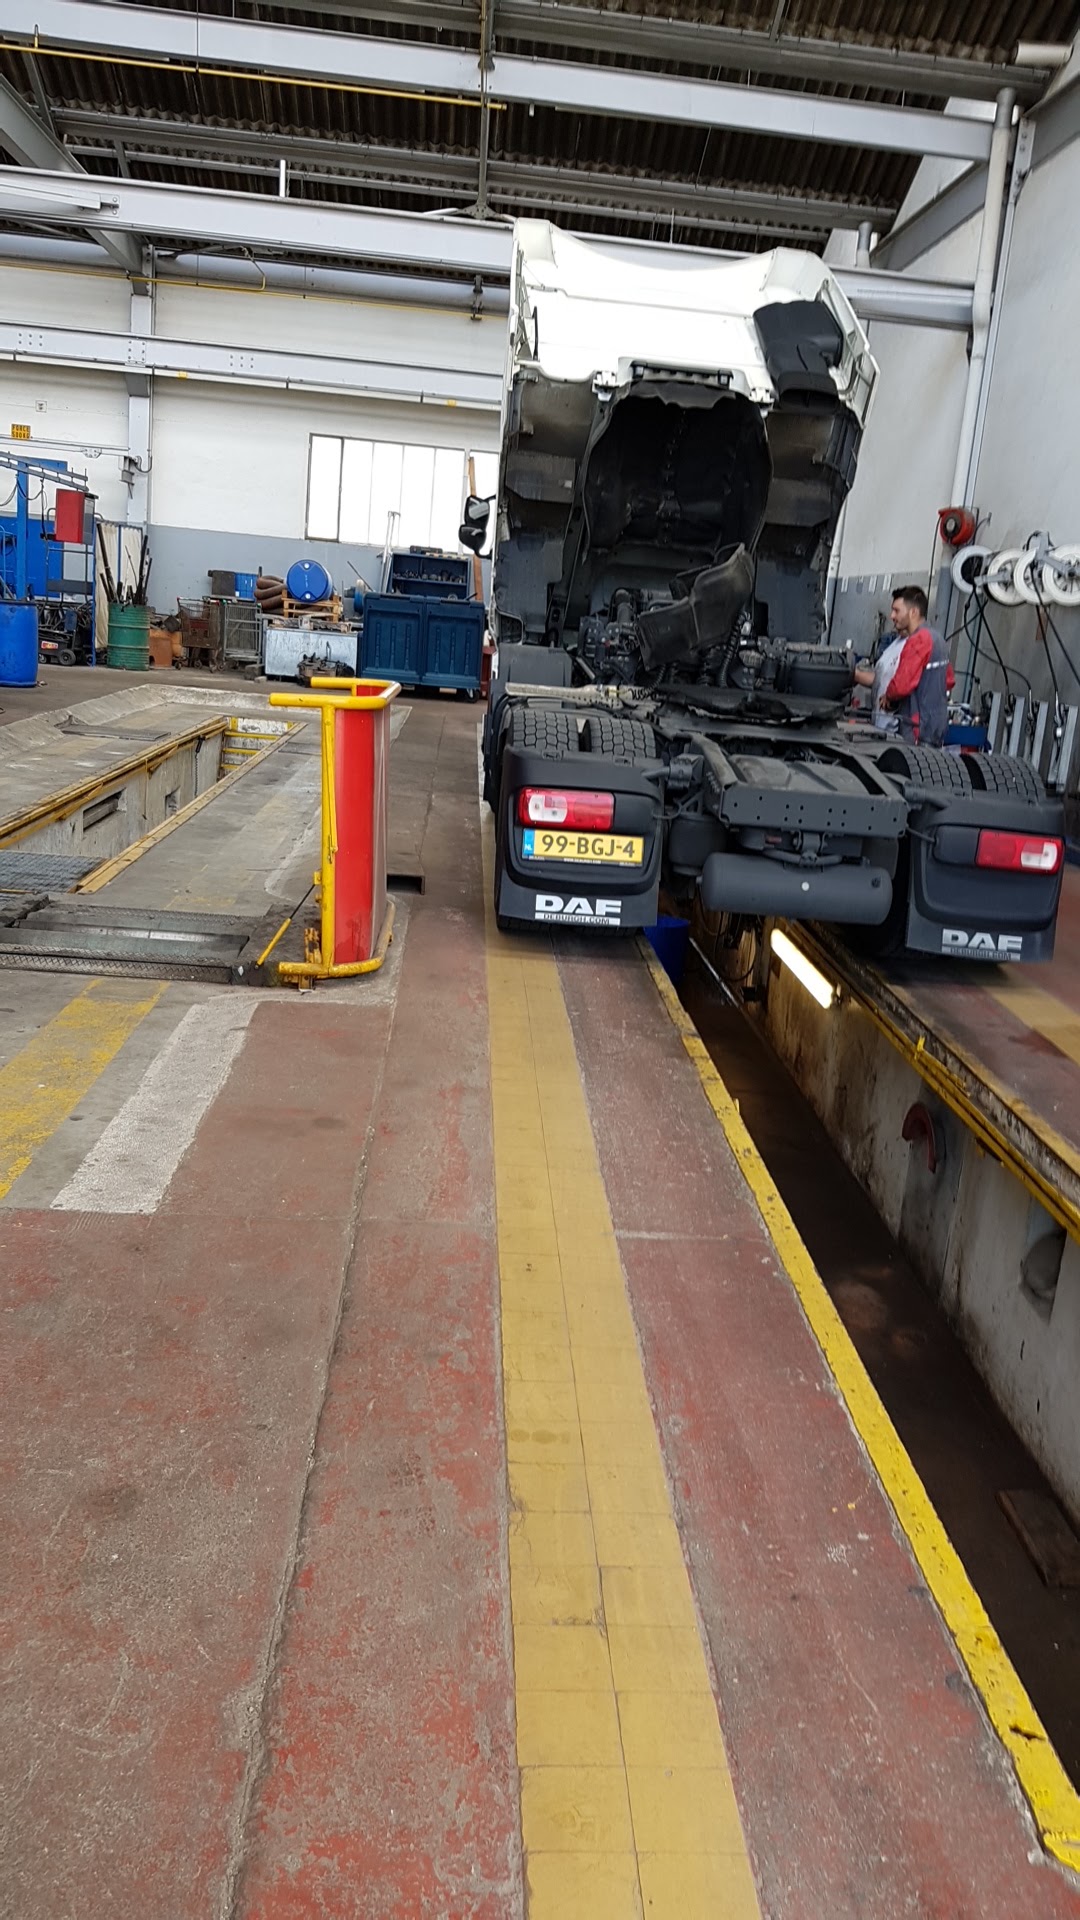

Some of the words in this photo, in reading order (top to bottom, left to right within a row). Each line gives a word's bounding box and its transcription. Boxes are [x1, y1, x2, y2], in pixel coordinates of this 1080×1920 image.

[542, 834, 635, 858] 99-BGJ-4
[535, 894, 622, 916] DAF
[942, 928, 1023, 951] DAF
